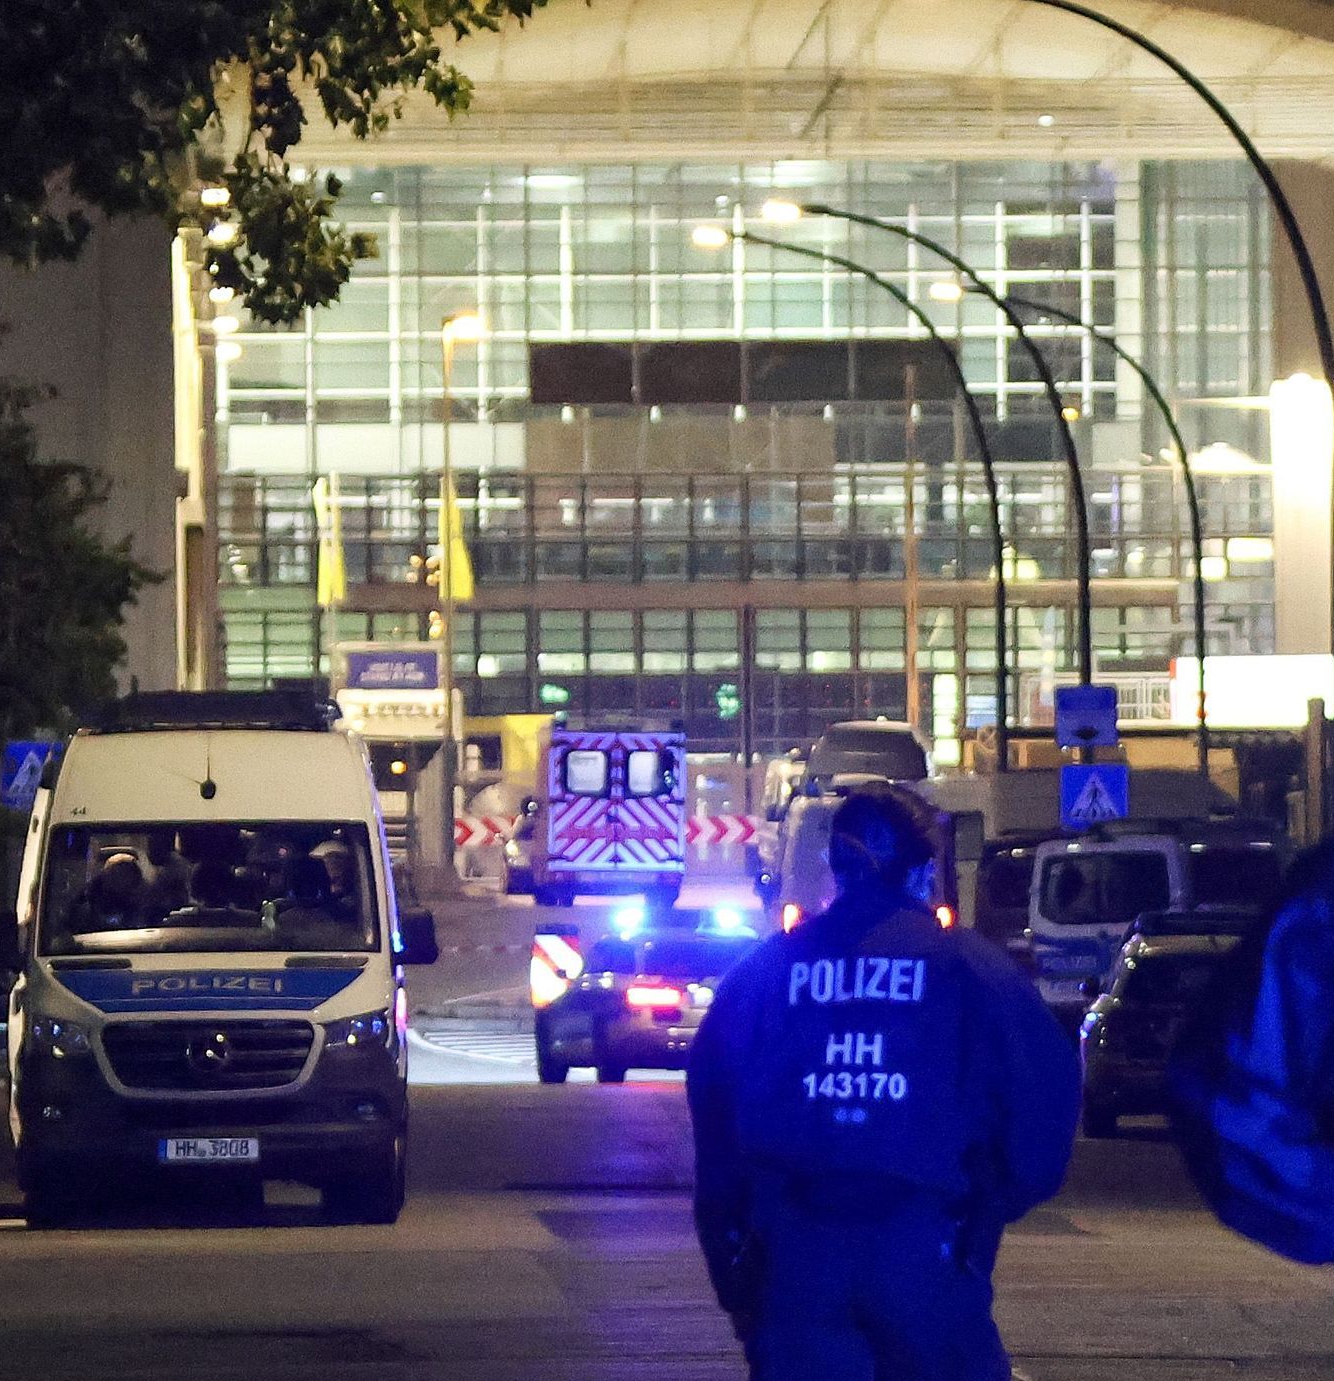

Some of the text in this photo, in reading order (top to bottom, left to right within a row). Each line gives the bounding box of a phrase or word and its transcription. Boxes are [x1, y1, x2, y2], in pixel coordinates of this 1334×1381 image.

[132, 976, 283, 995] POLIZEI
[789, 957, 925, 1006] POLIZEI
[826, 1032, 883, 1065] HH
[803, 1071, 908, 1100] 143170
